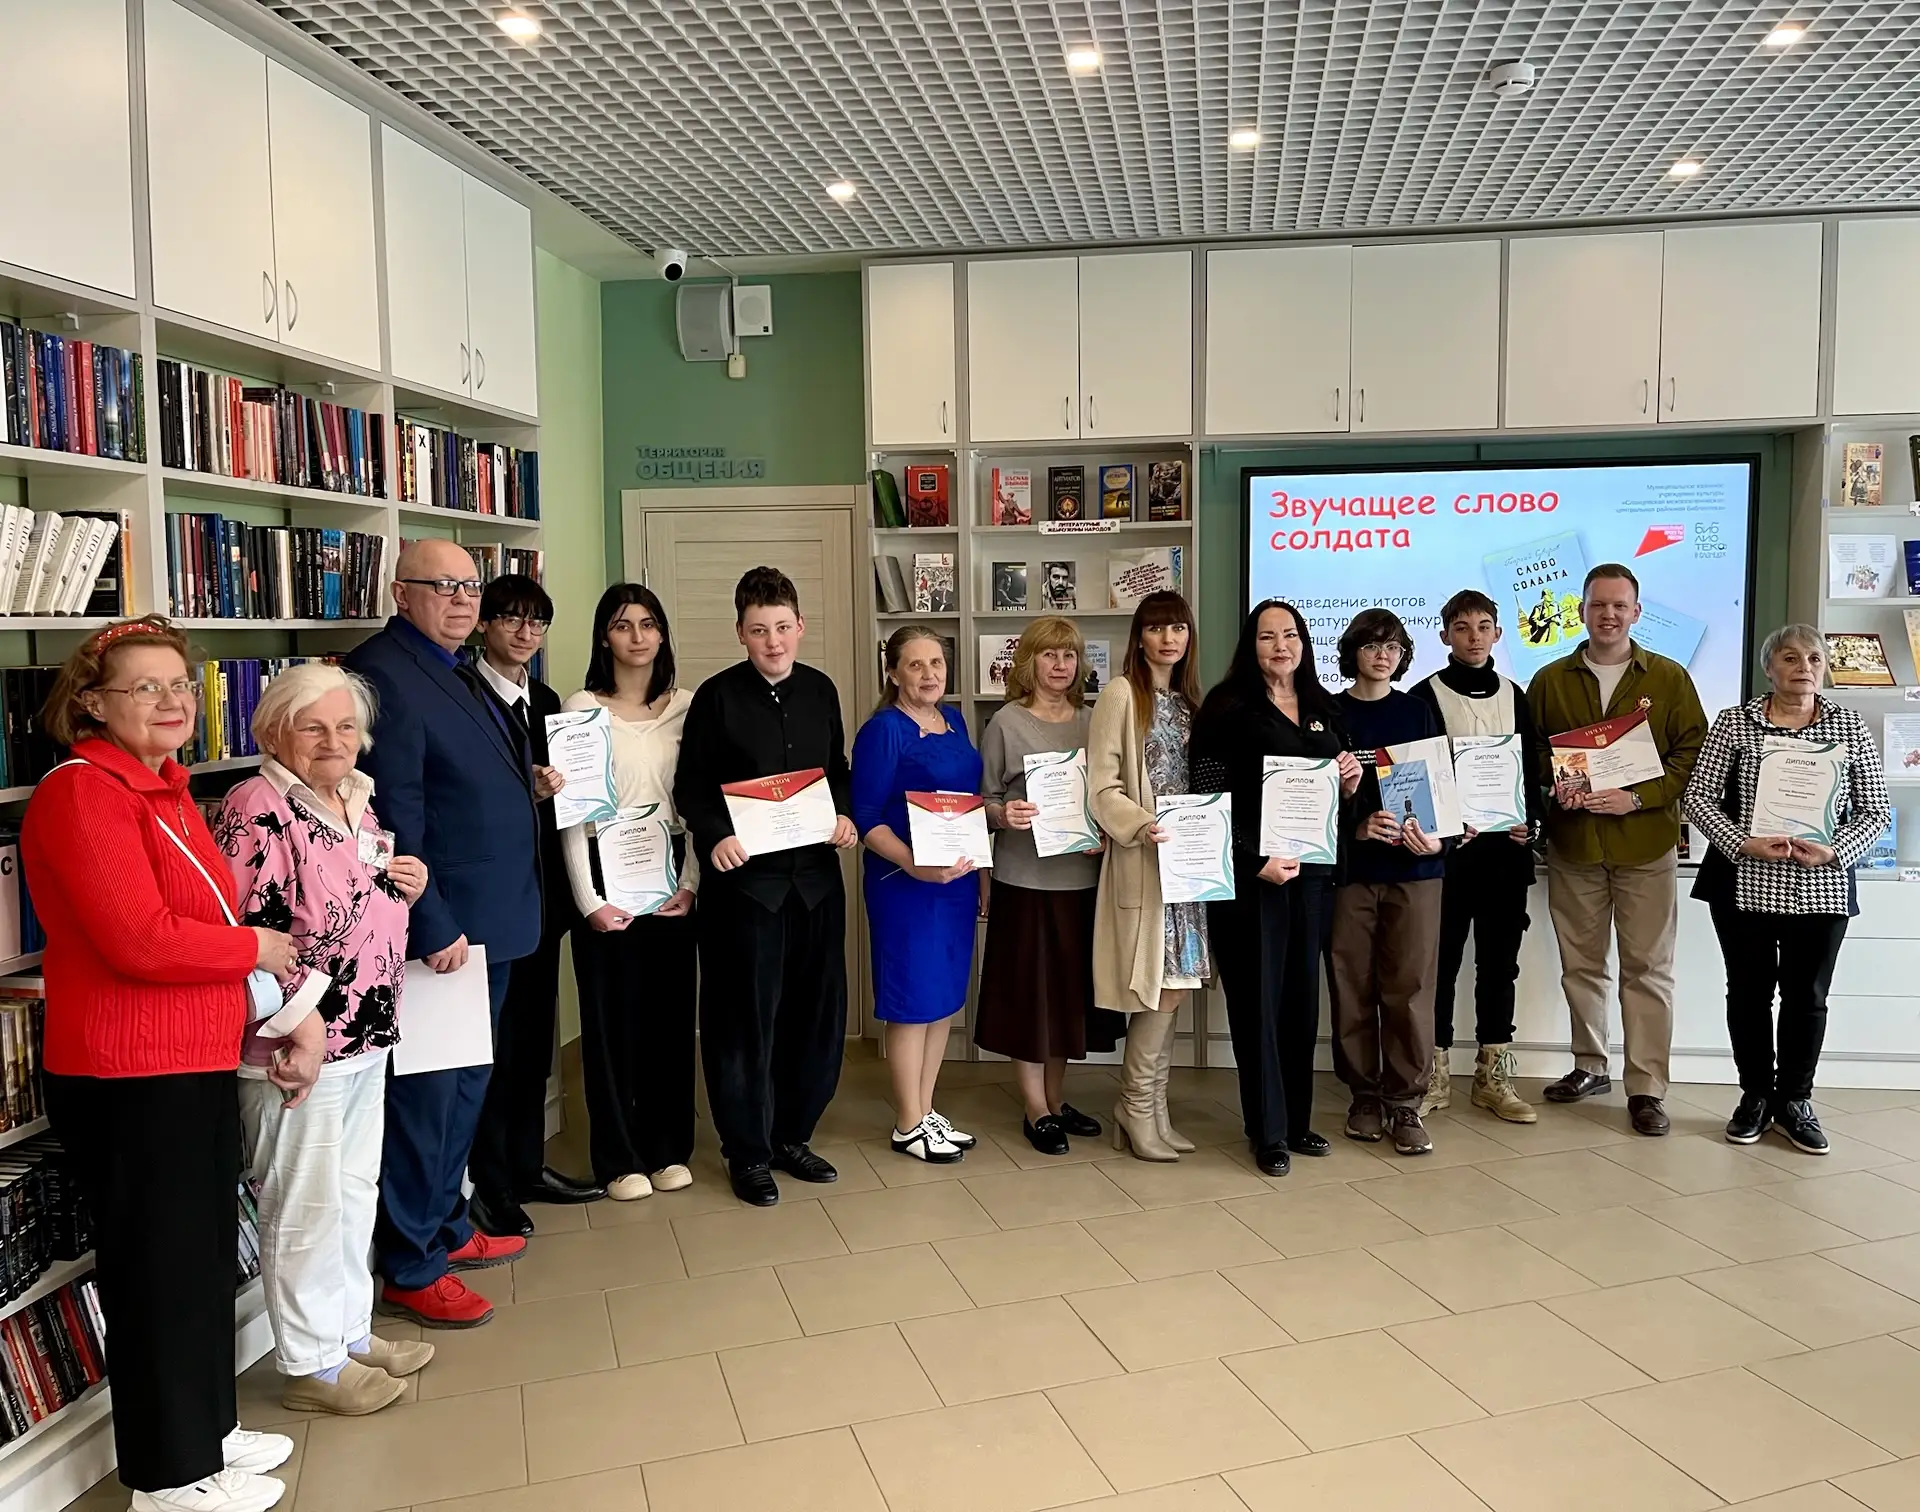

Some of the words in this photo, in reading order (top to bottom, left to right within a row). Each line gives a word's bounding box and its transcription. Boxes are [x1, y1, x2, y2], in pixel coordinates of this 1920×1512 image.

[636, 459, 766, 482] ОБЩЕНИЯ
[1269, 490, 1437, 527] Звучащее
[1453, 491, 1560, 515] слово
[1269, 528, 1411, 553] солдата
[1516, 557, 1557, 576] СЛОВО
[1512, 569, 1568, 592] СОЛДАТА
[1373, 597, 1426, 608] итогов
[566, 731, 590, 742] ДИПЛОМ
[1474, 753, 1500, 761] ДИПЛОМ
[1785, 757, 1817, 766] ДИПЛОМ
[1044, 770, 1067, 779] ДИПЛОМ
[1178, 814, 1207, 822] ДИПЛОМ
[619, 826, 647, 836] ДИПЛОМ
